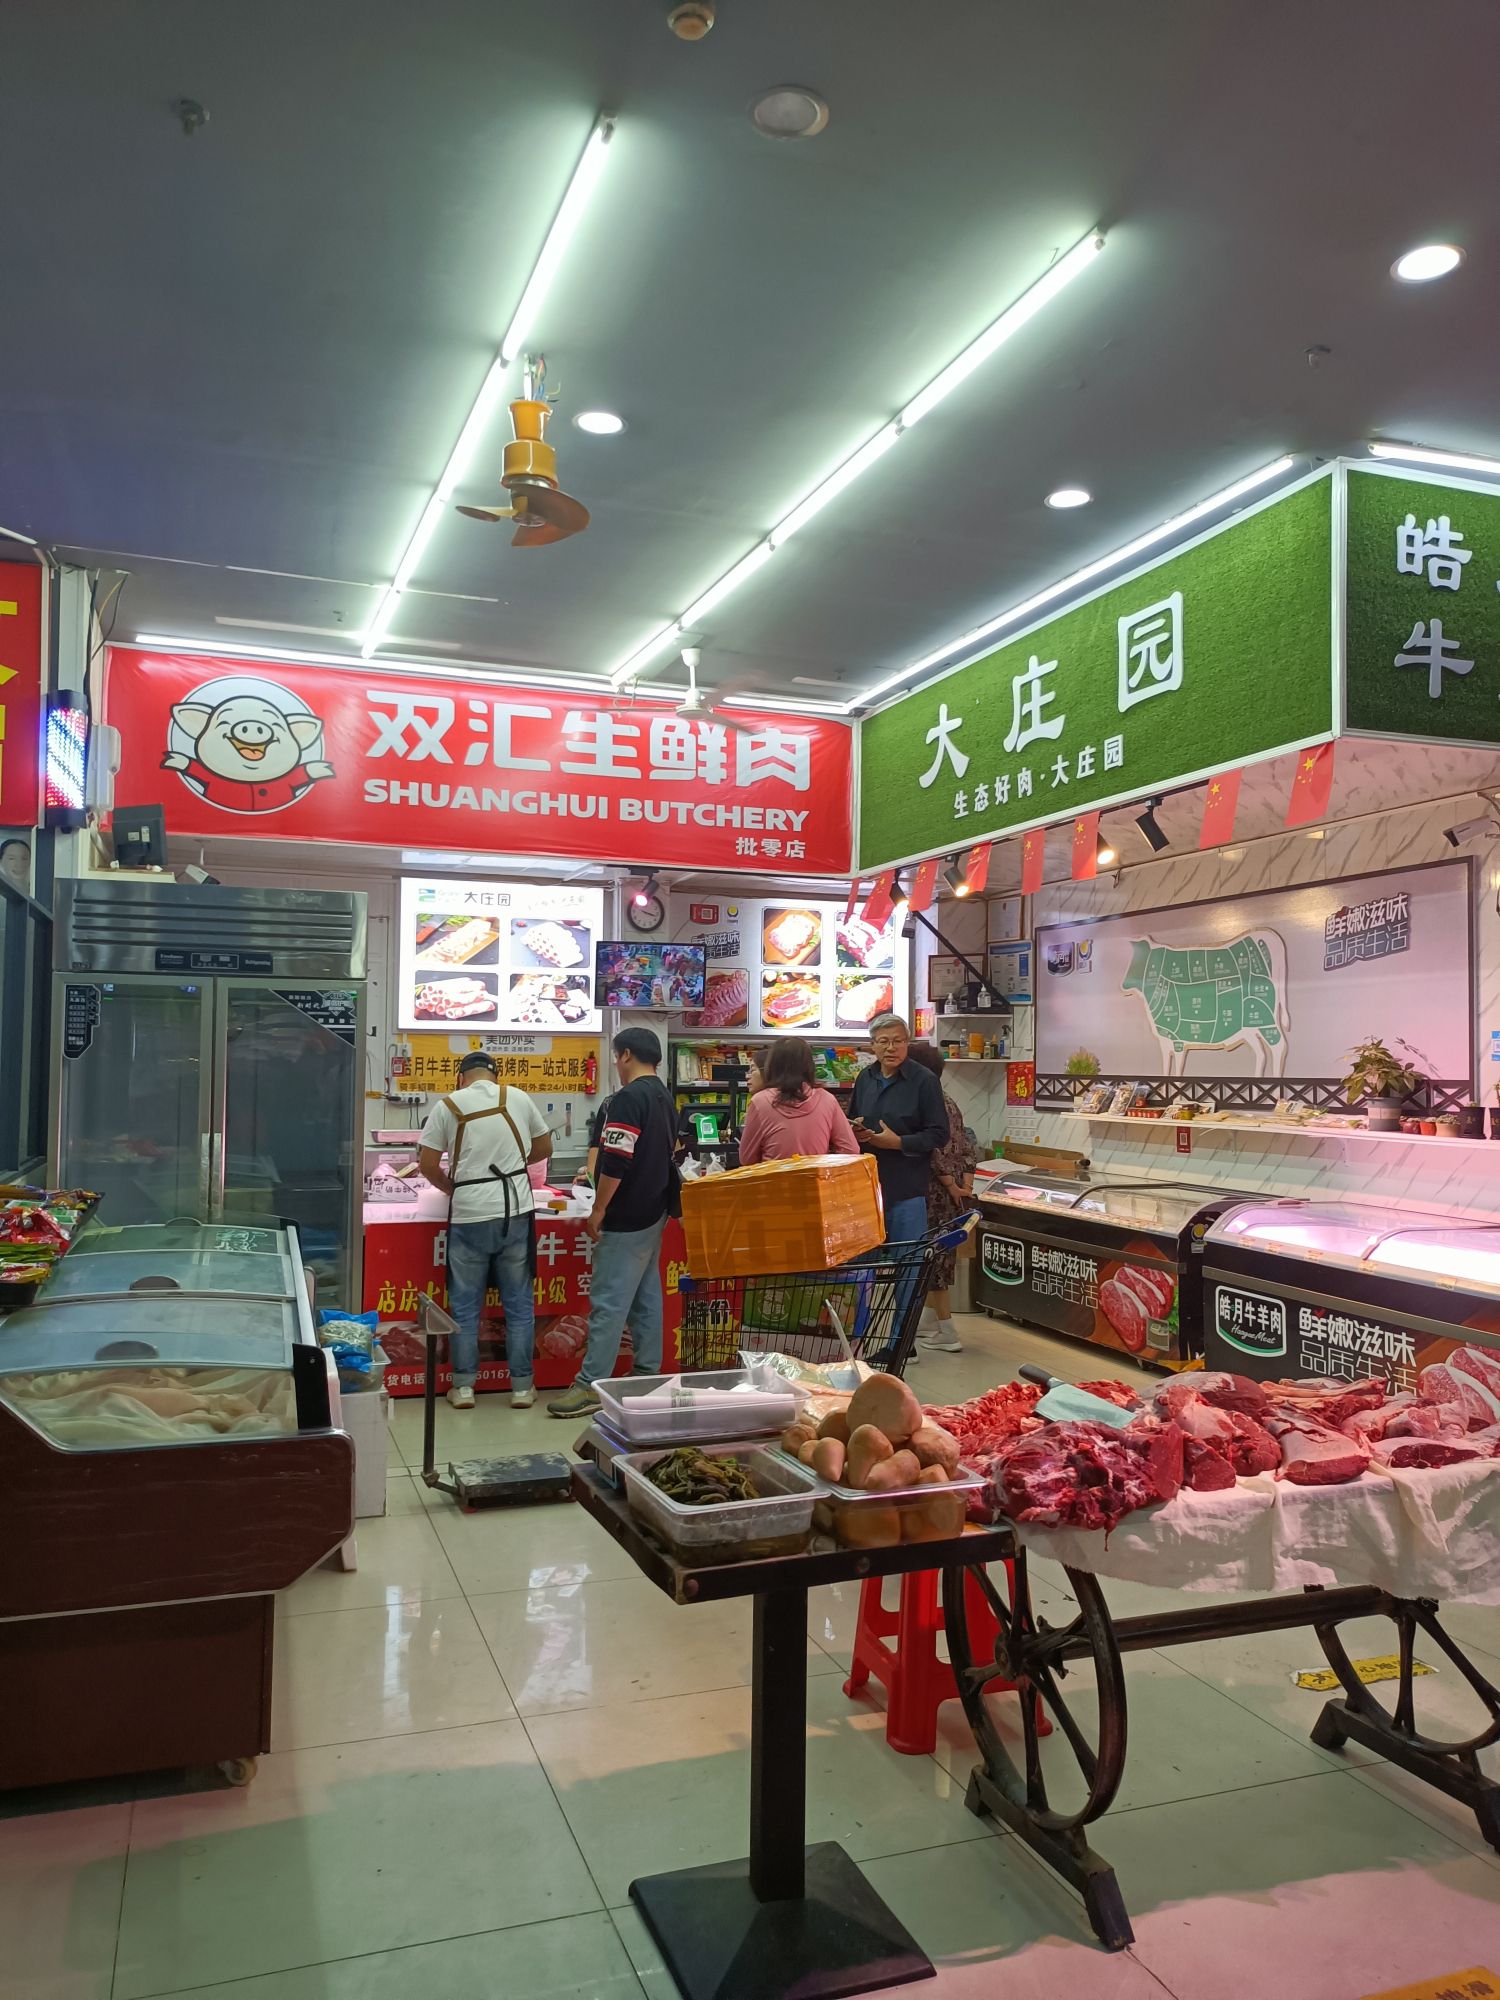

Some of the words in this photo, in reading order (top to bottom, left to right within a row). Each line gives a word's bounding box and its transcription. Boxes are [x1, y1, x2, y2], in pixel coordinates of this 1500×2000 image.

[1396, 513, 1473, 591] 皓
[1393, 618, 1475, 699] 牛
[918, 590, 1184, 788] 大庄园
[364, 691, 811, 791] 双汇生鲜肉
[953, 734, 1124, 819] 生态好肉·大庄园
[363, 778, 609, 820] SHUANGHUI
[619, 798, 810, 833] BUTCHERY
[735, 837, 806, 859] 批零店
[464, 891, 511, 907] 大庄园
[1325, 892, 1409, 937] 鲜嫩滋味
[1324, 922, 1408, 970] 品质生活
[485, 1035, 535, 1046] 美团外卖
[1015, 1076, 1028, 1098] 福
[984, 1239, 1022, 1268] 皓月牛羊肉
[1031, 1245, 1098, 1284] 鲜嫩滋味
[1031, 1269, 1099, 1310] 品质生活
[1219, 1294, 1282, 1335] 皓月牛羊肉
[1299, 1306, 1417, 1368] 鲜嫩滋味
[1300, 1339, 1418, 1397] 品质生活
